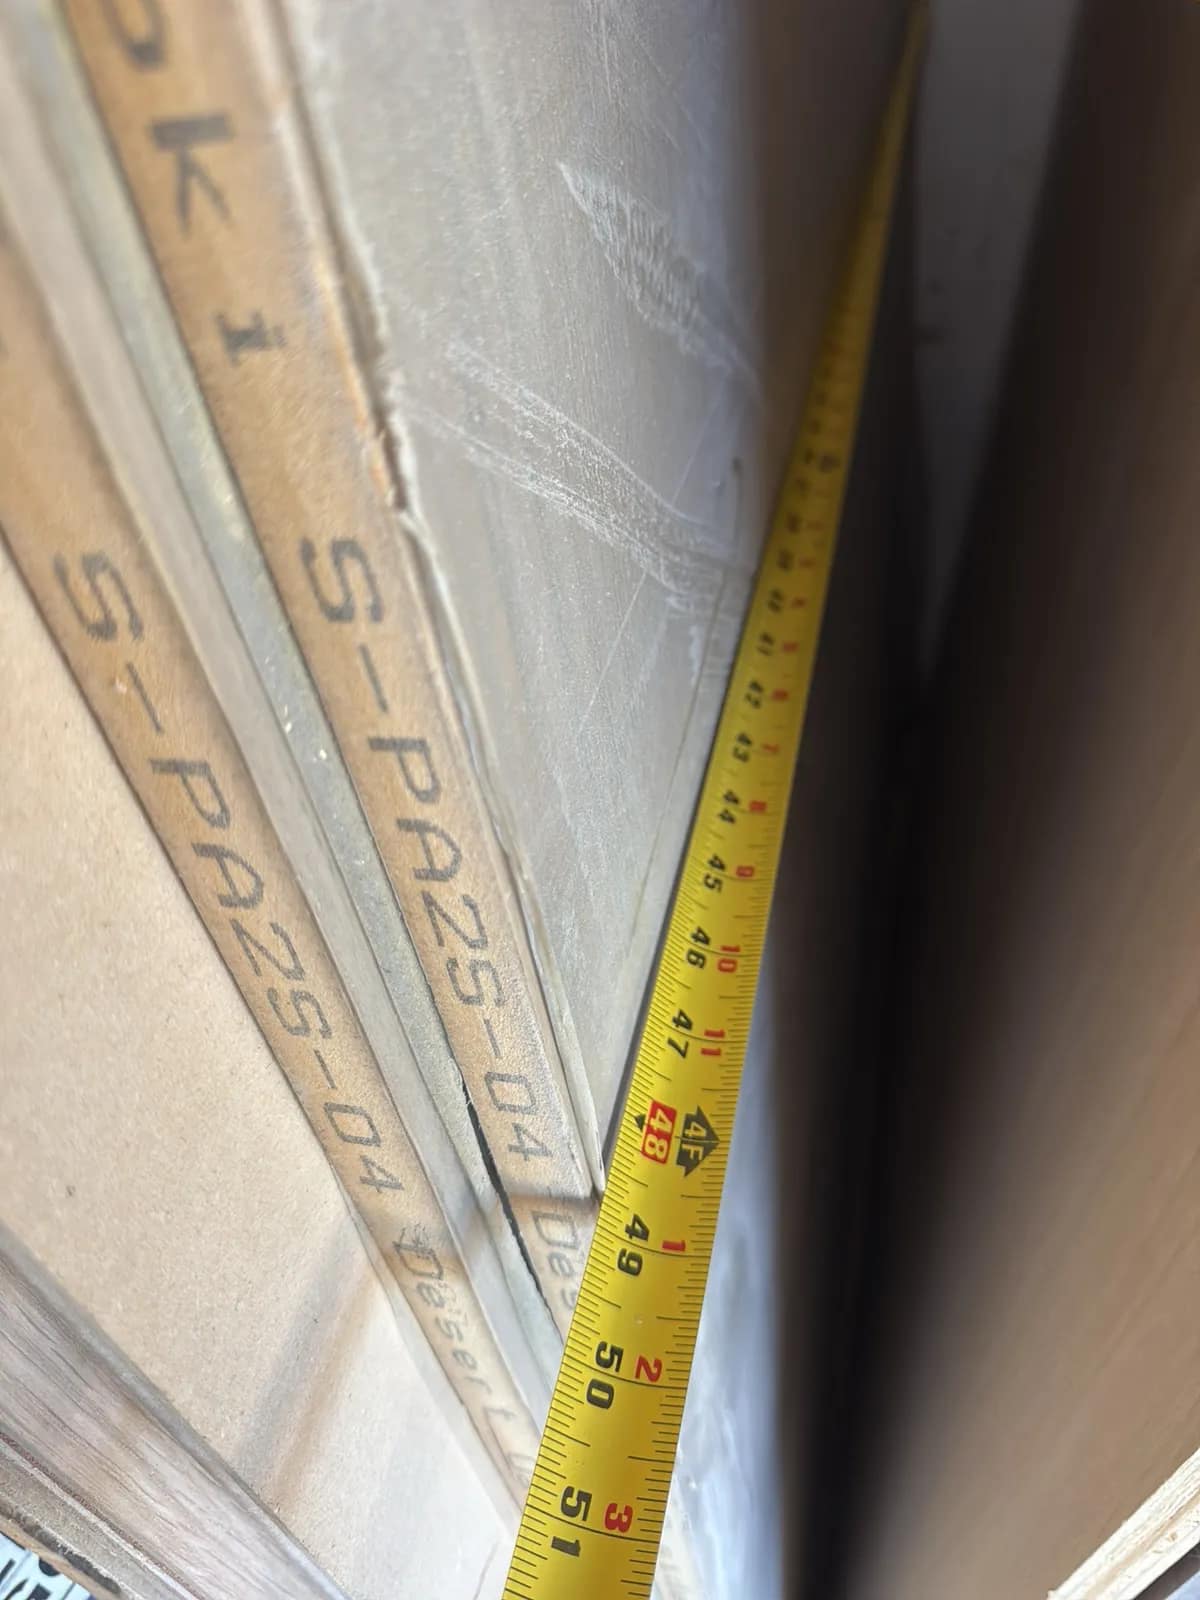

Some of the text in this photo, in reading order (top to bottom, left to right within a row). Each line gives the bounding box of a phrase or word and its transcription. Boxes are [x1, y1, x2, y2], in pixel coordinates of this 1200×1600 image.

[732, 732, 754, 763] 43
[717, 790, 741, 824] 44
[703, 853, 726, 894] 45
[685, 926, 711, 970] 46
[717, 944, 741, 974] 10
[666, 1008, 693, 1059] 47
[700, 1028, 726, 1058] 11
[643, 1106, 673, 1160] 48
[680, 1121, 708, 1168] 4F
[616, 1214, 650, 1277] 49
[661, 1239, 686, 1254] 1
[586, 1340, 624, 1411] 50
[635, 1354, 663, 1384] 2
[551, 1485, 593, 1558] 51
[603, 1502, 634, 1534] 3
